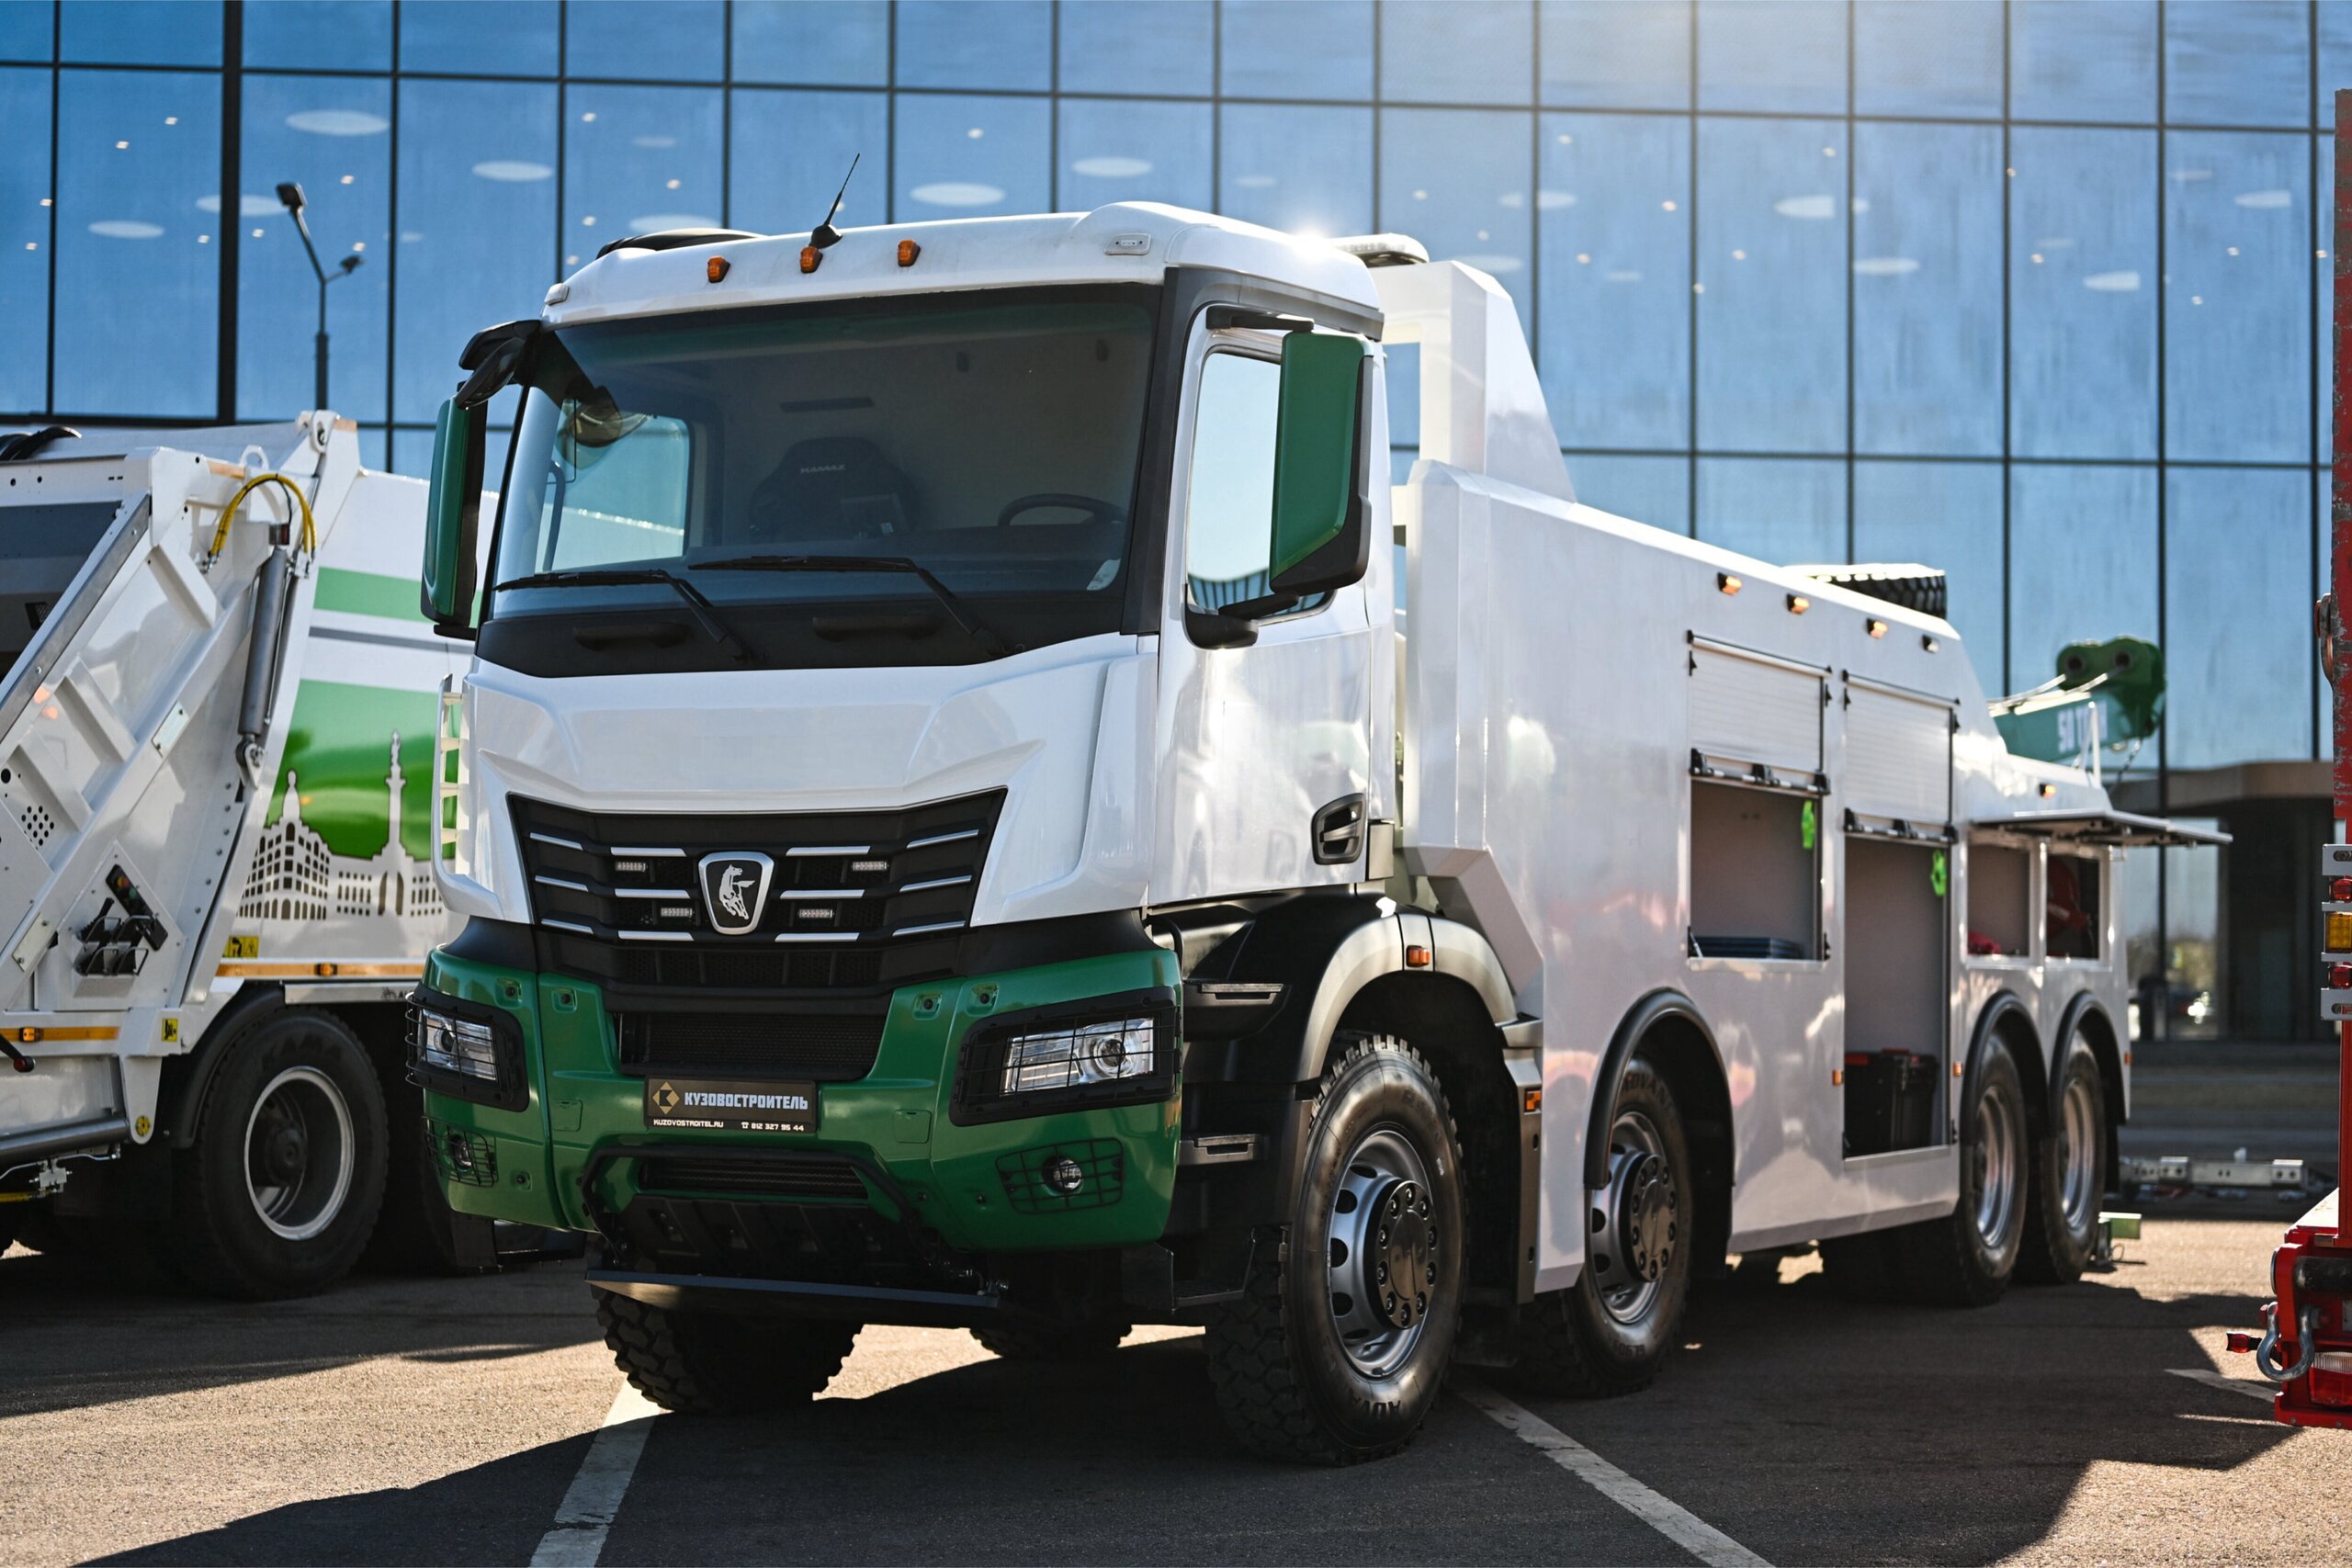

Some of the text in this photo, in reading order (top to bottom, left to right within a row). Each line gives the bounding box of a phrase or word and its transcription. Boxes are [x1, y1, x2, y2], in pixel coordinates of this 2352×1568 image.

[800, 464, 845, 474] KAMAZ
[684, 1092, 808, 1110] КУЗОВОСТРОИТЕЛЬ
[653, 1119, 724, 1128] KUZOVOSTROITEL.RU
